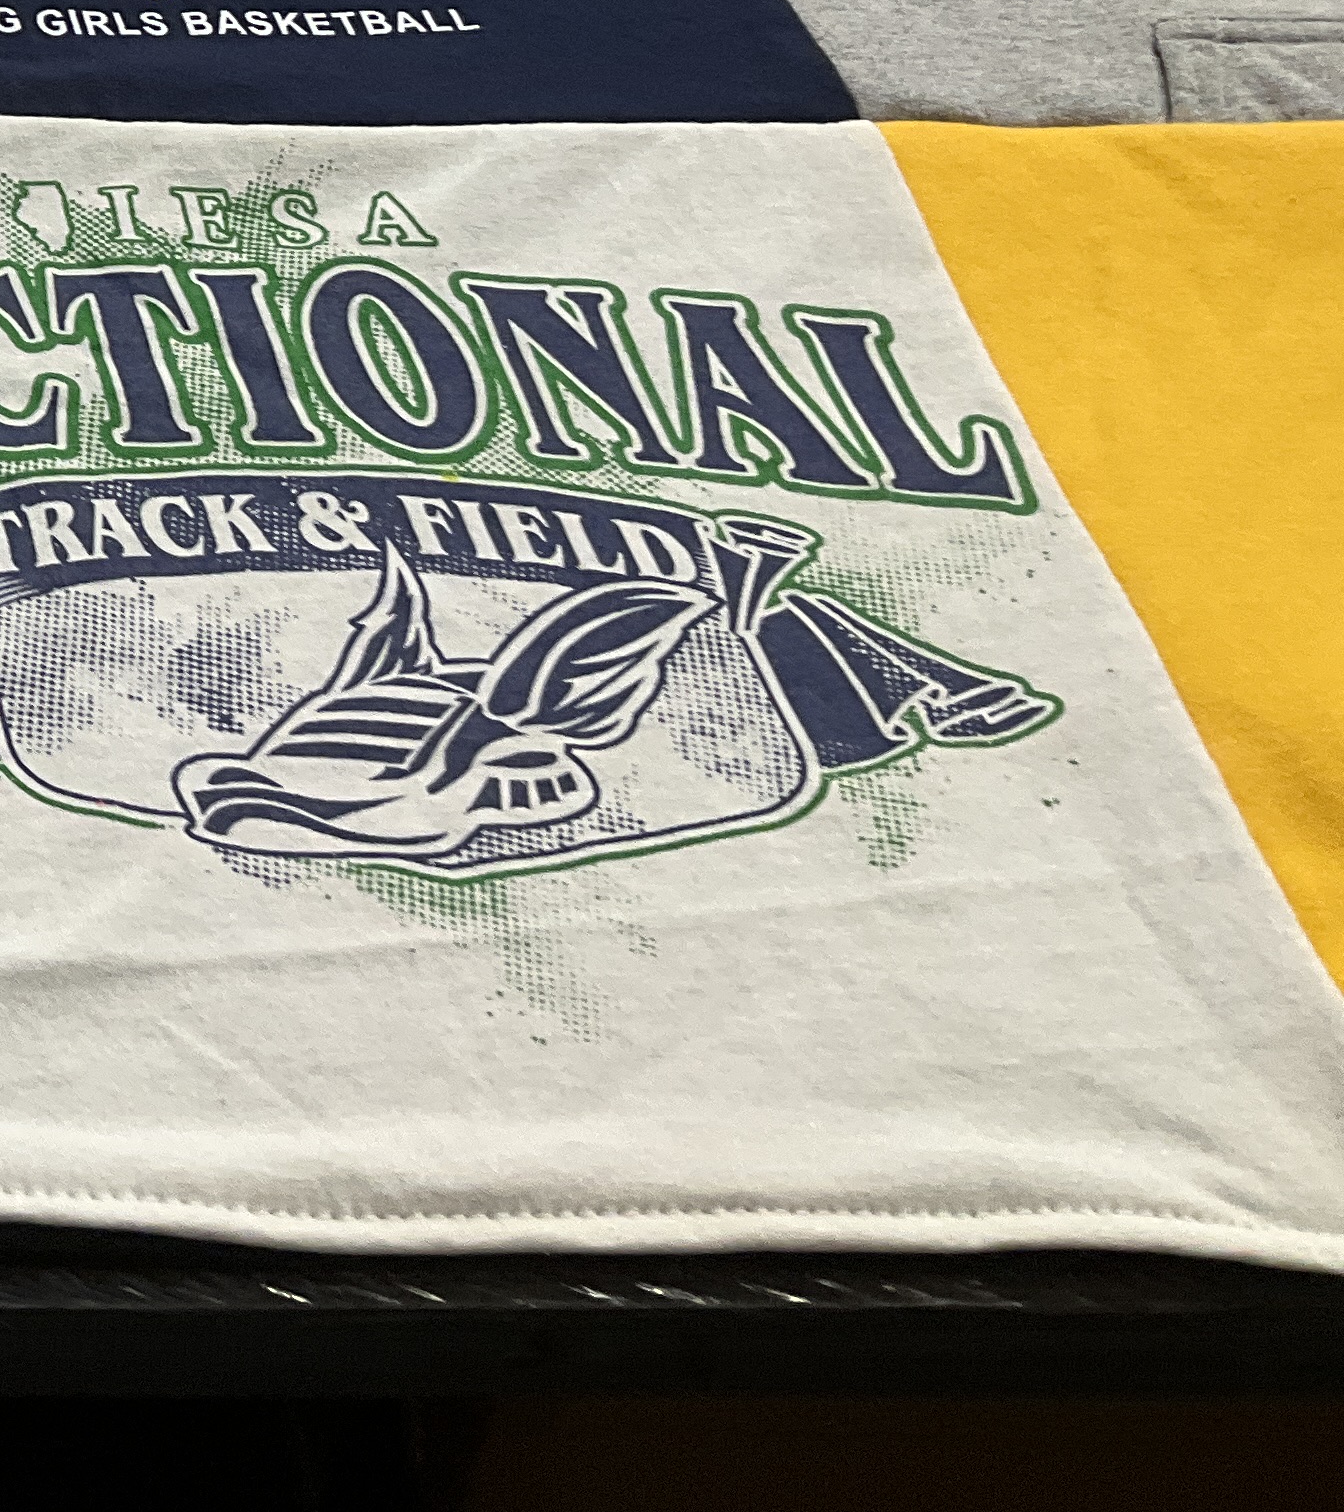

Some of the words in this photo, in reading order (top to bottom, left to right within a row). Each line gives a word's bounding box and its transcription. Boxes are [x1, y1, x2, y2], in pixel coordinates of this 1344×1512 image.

[35, 10, 168, 37] GIRLS
[183, 9, 482, 37] BASKETBALL
[297, 491, 374, 556] &
[414, 498, 692, 583] FIELD
